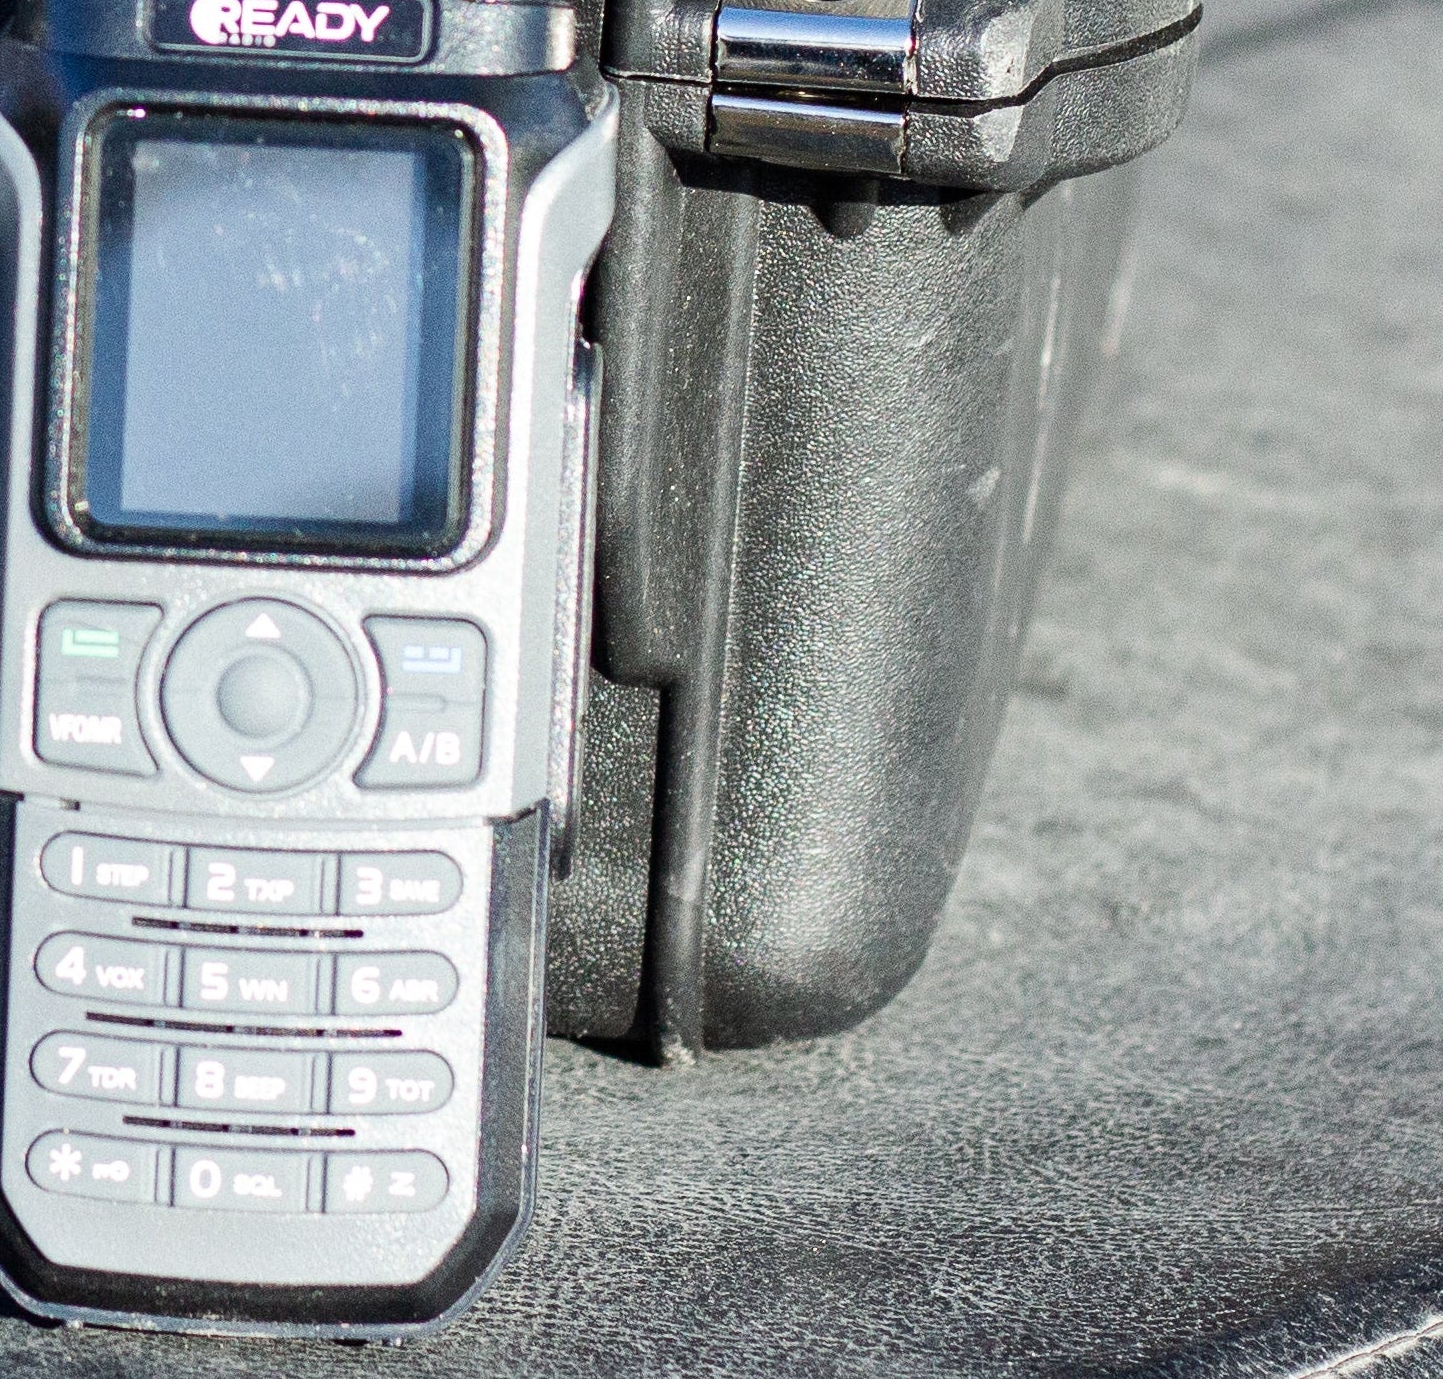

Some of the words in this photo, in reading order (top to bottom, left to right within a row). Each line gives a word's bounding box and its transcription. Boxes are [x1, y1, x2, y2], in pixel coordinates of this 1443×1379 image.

[389, 730, 461, 765] A/B
[71, 846, 84, 885] 1
[206, 862, 236, 901] 2
[244, 878, 295, 903] TXP
[355, 866, 383, 906] 3
[55, 946, 87, 985] 4
[95, 965, 145, 990] VOX
[200, 962, 229, 1001] 5
[350, 966, 381, 1005] 6
[58, 1046, 86, 1084] 7
[88, 1065, 137, 1090] TDR
[194, 1060, 225, 1099] 8
[348, 1066, 378, 1104] 9
[384, 1078, 436, 1102] TOT
[189, 1159, 222, 1199] 0
